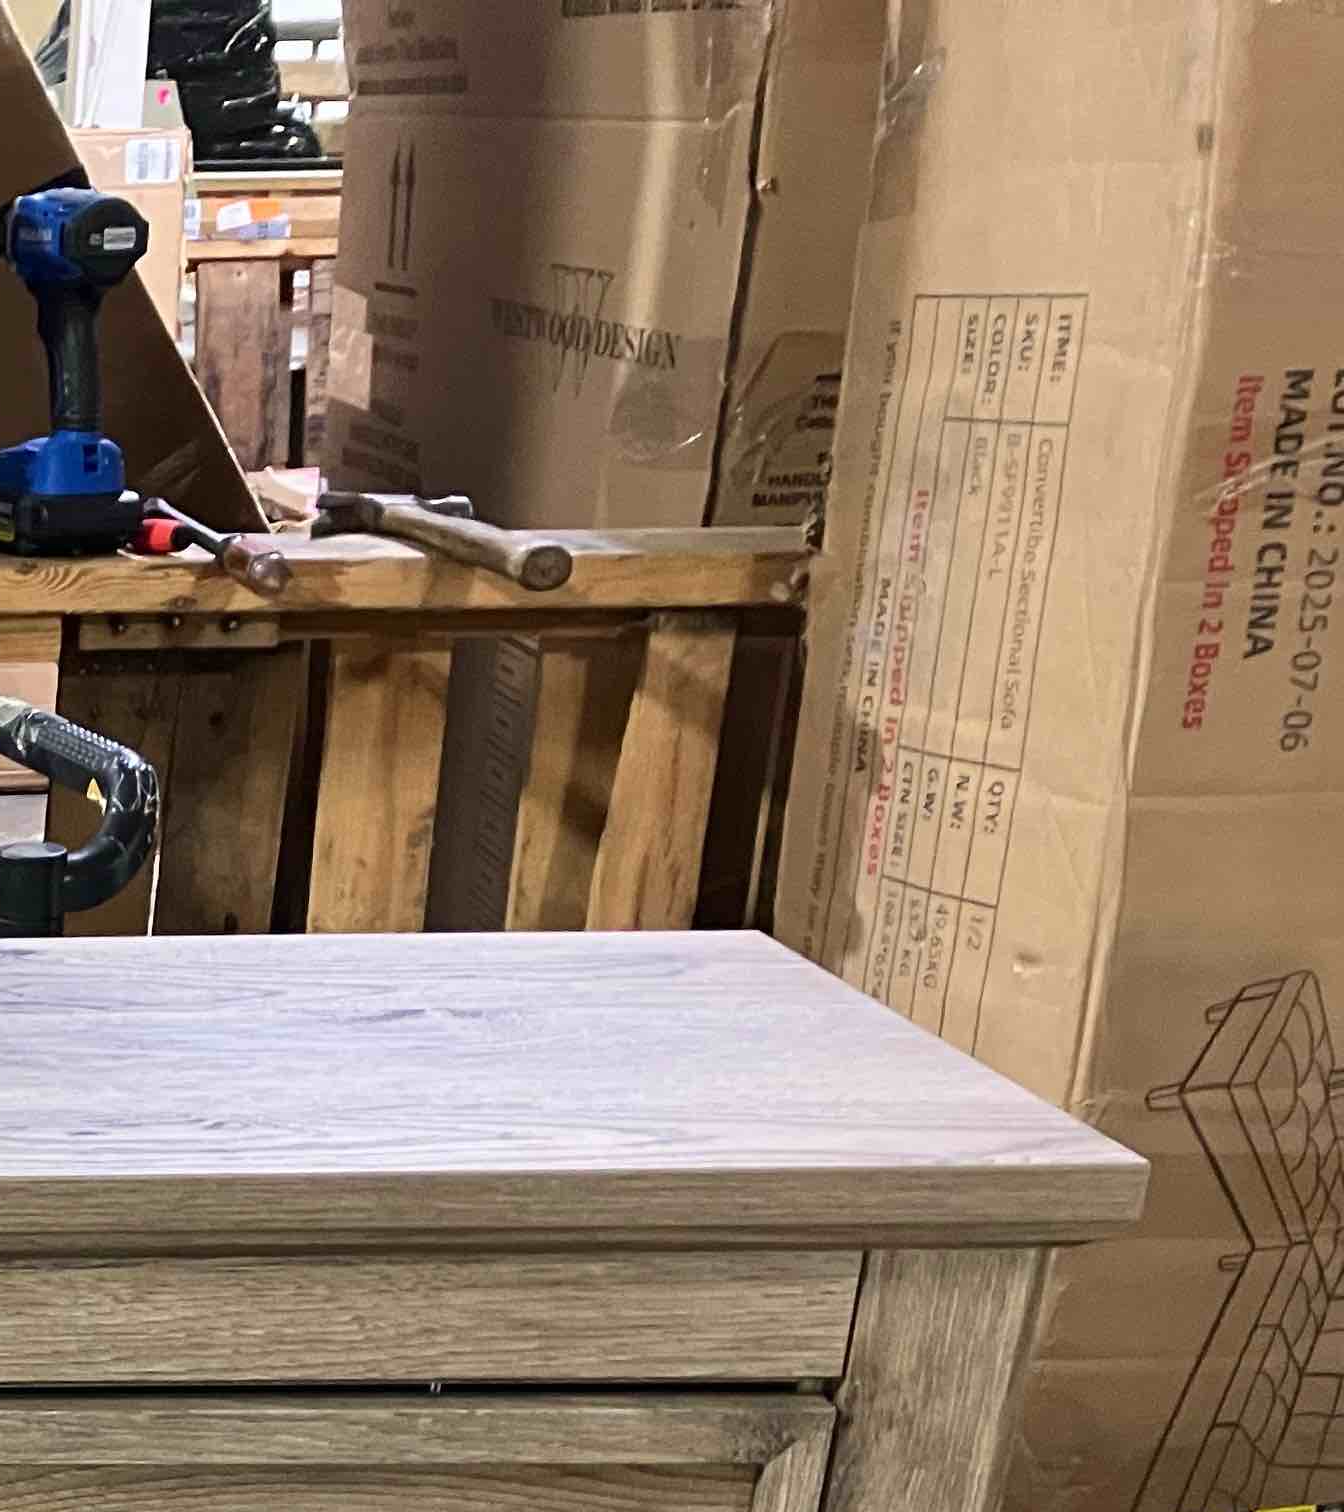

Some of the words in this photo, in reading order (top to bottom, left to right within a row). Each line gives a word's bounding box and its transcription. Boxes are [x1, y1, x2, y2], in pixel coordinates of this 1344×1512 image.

[592, 320, 681, 370] DESIGN
[961, 313, 980, 375] SIZE:
[981, 313, 1007, 405] COLOR:
[1016, 312, 1040, 373] SKU:
[1049, 314, 1072, 383] ITME:
[1230, 376, 1265, 444] Item
[1270, 368, 1315, 479] MADE
[967, 437, 988, 497] Black
[909, 489, 930, 562] Item
[1261, 490, 1295, 531] IN
[870, 577, 892, 650] MADE
[1198, 618, 1224, 635] 2
[1243, 541, 1288, 660] CHINA
[866, 661, 880, 688] IN
[1280, 548, 1339, 753] 2025-07-06
[1182, 643, 1221, 731] Boxes
[853, 695, 875, 773] CHINA
[900, 760, 914, 804] CTN
[984, 781, 1005, 833] QTY:
[866, 784, 892, 876] Boxes
[967, 914, 987, 950] 1/2
